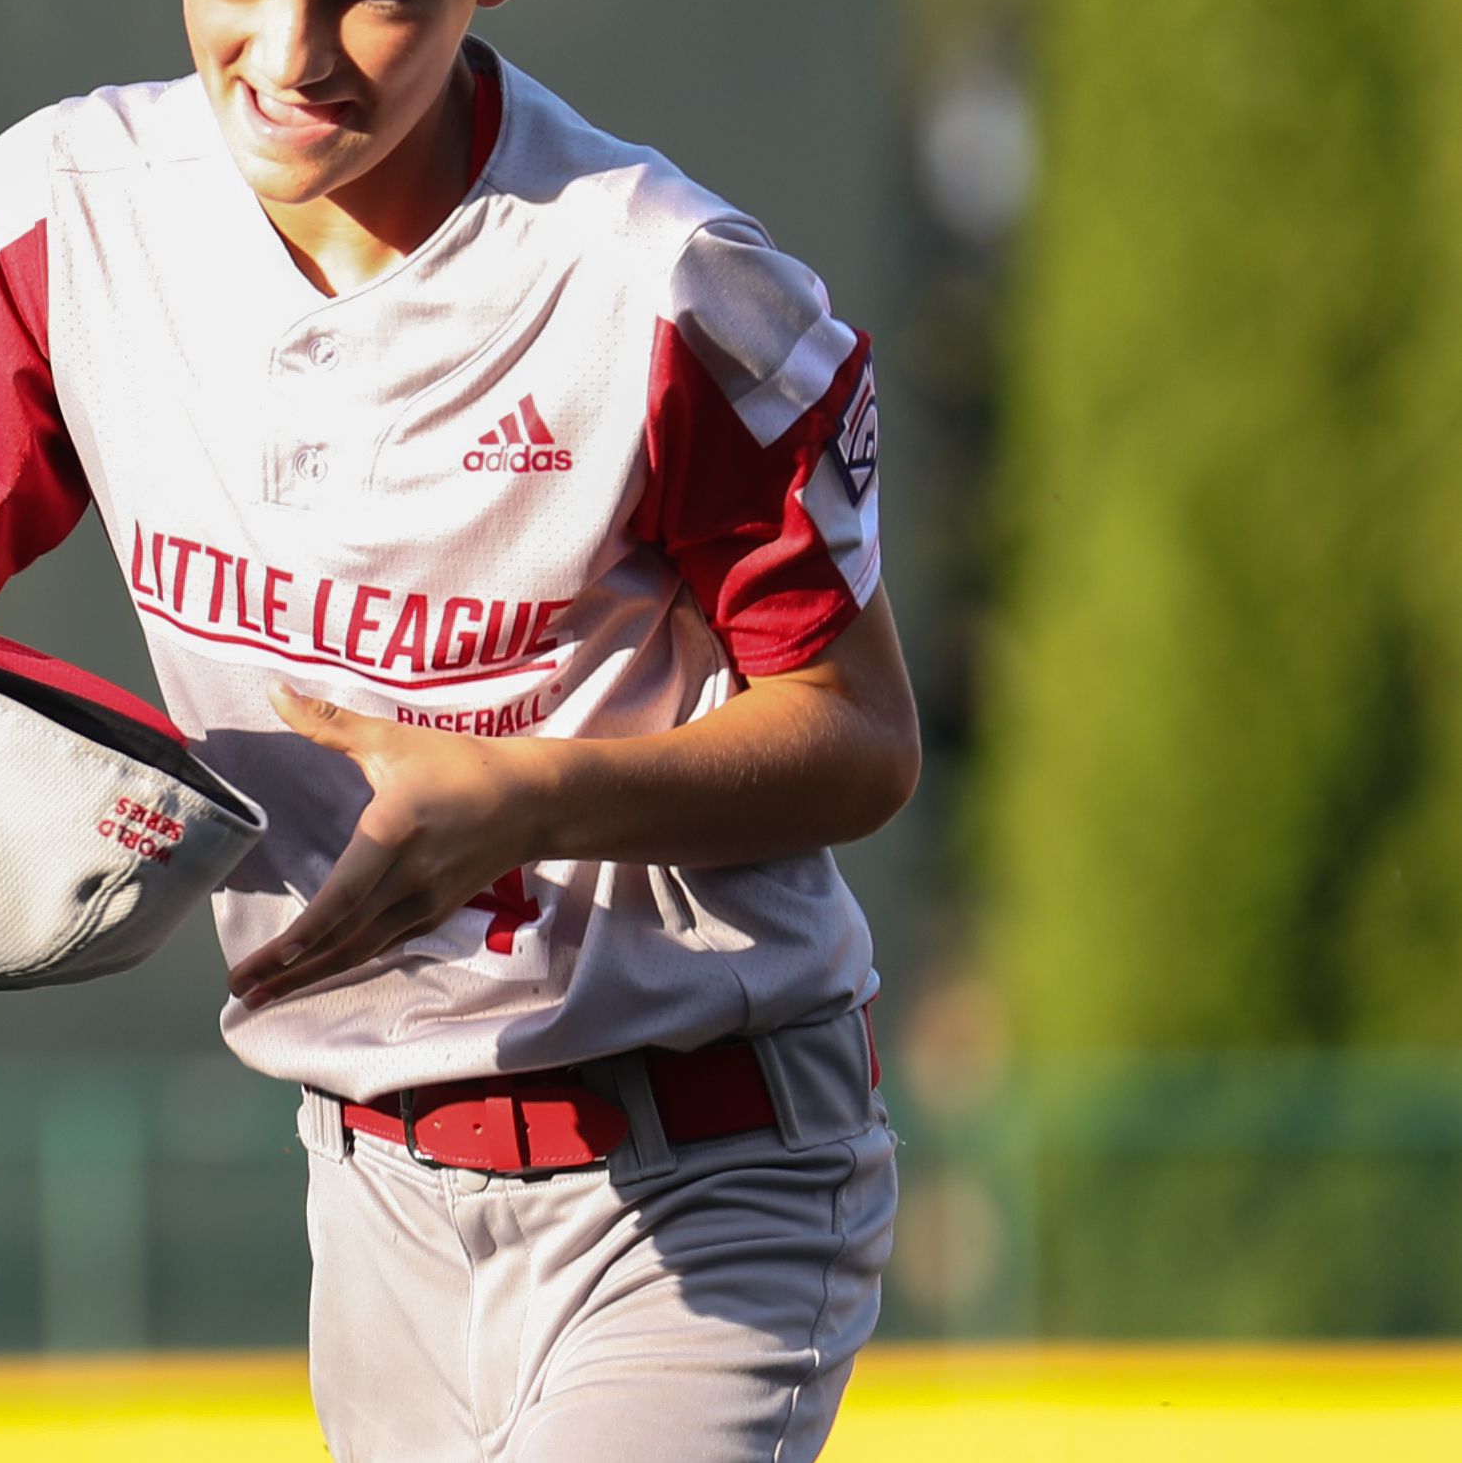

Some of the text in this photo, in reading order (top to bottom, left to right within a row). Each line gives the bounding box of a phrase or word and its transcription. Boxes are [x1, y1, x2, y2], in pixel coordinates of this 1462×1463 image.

[463, 444, 573, 474] adidas
[131, 519, 574, 674] LITTLE LEAGUE
[115, 796, 185, 841] SERIES
[98, 819, 173, 867] WORLD
